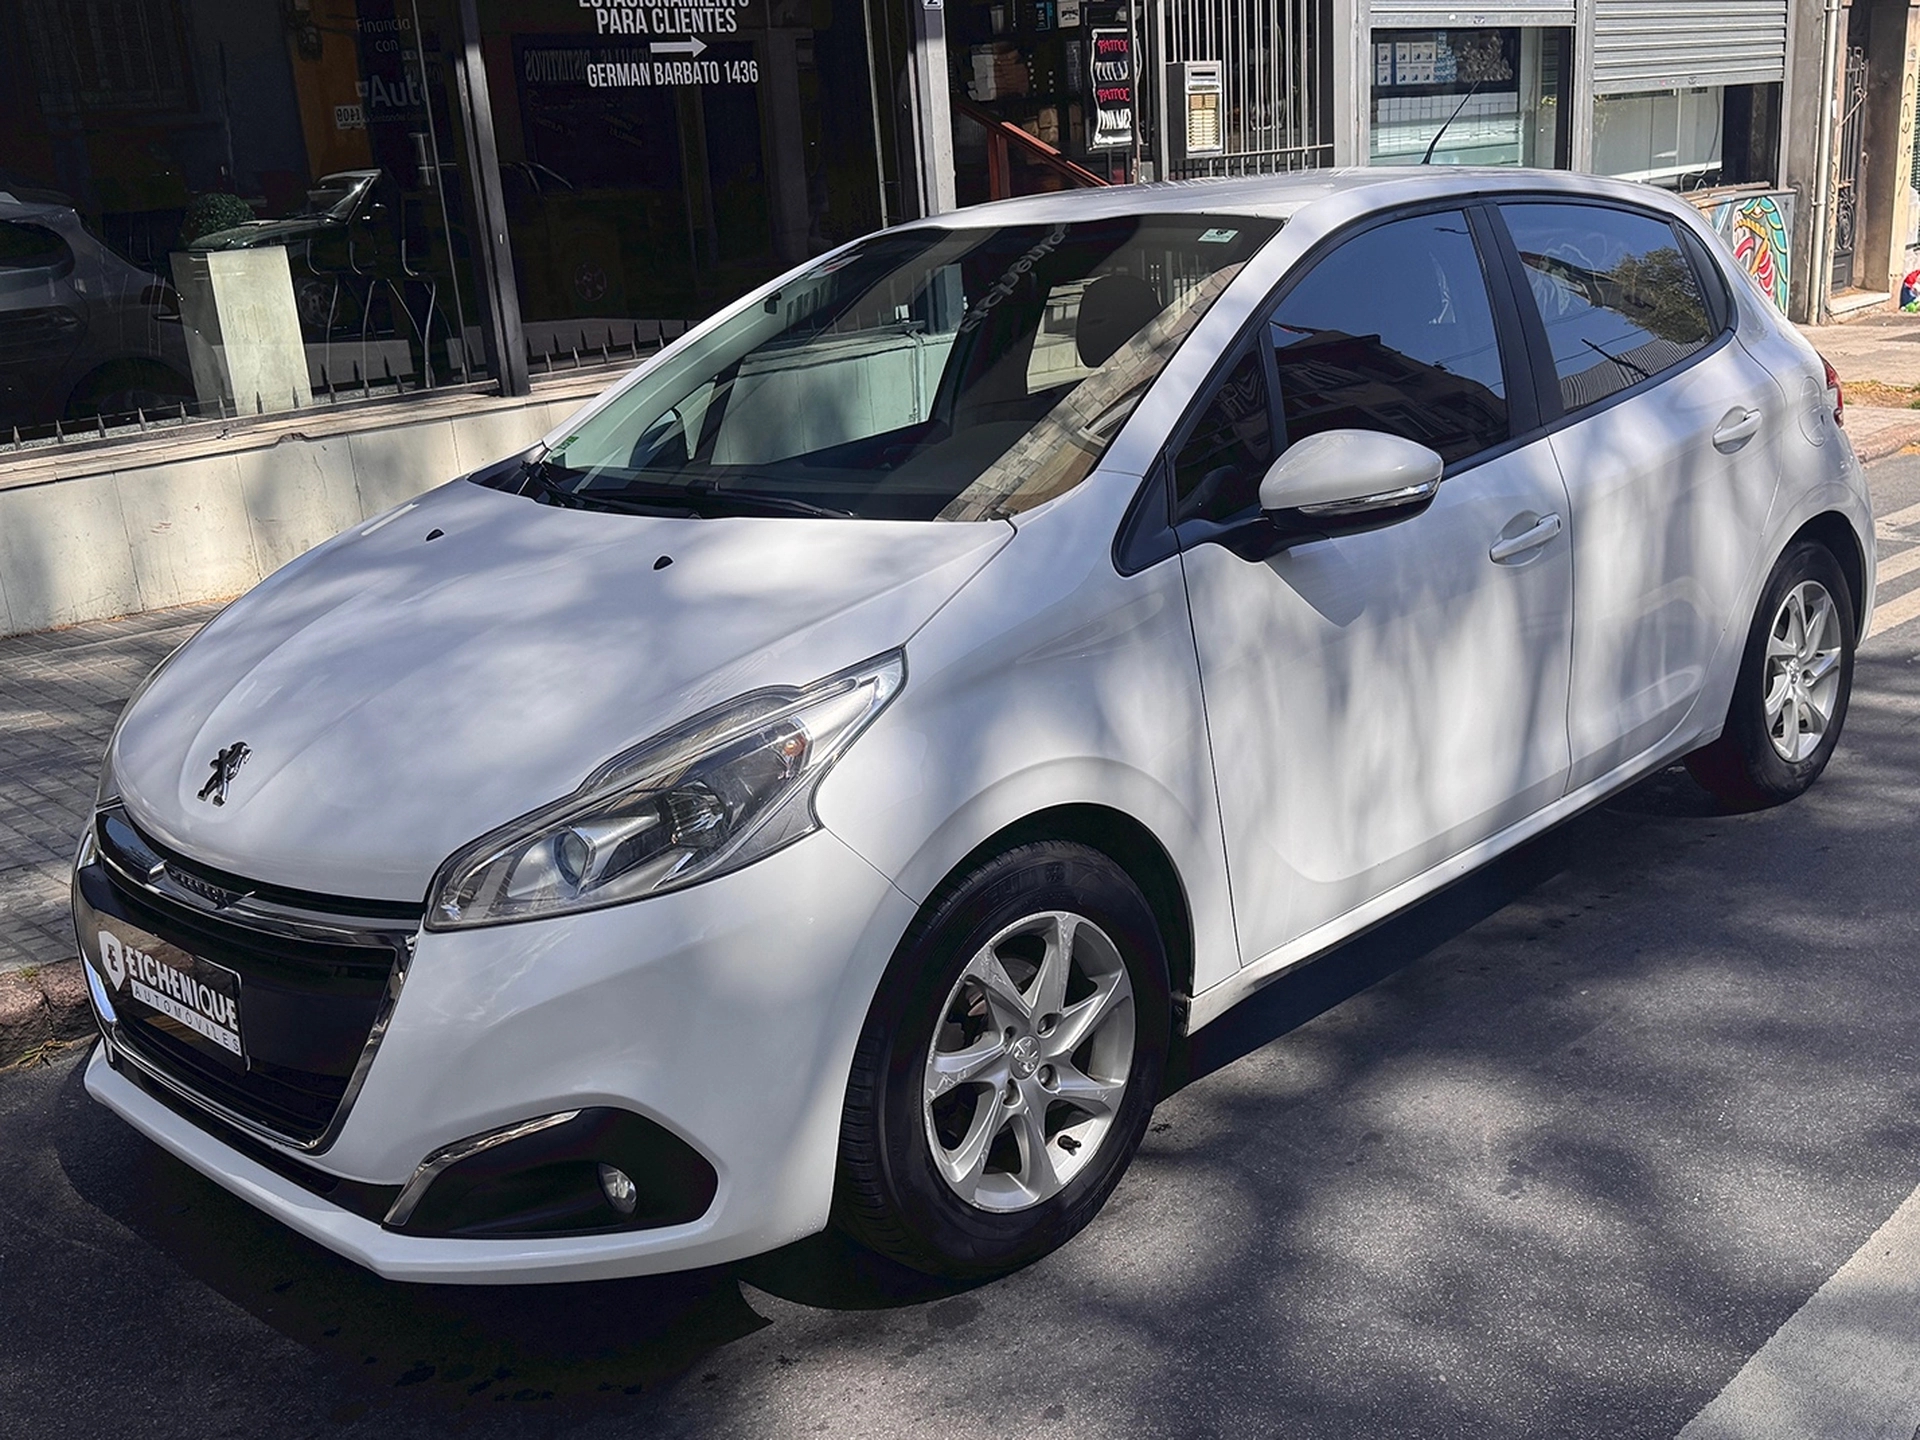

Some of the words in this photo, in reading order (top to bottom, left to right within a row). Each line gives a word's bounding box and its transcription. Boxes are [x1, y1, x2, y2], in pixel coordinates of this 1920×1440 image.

[355, 14, 411, 33] Financia
[596, 8, 648, 34] PARA
[652, 7, 737, 33] CLIENTES
[375, 39, 399, 52] con
[587, 63, 651, 87] GERMAN
[654, 61, 719, 85] BARBATO
[724, 60, 759, 83] 1436
[125, 945, 238, 1032] ETCHENIQUE
